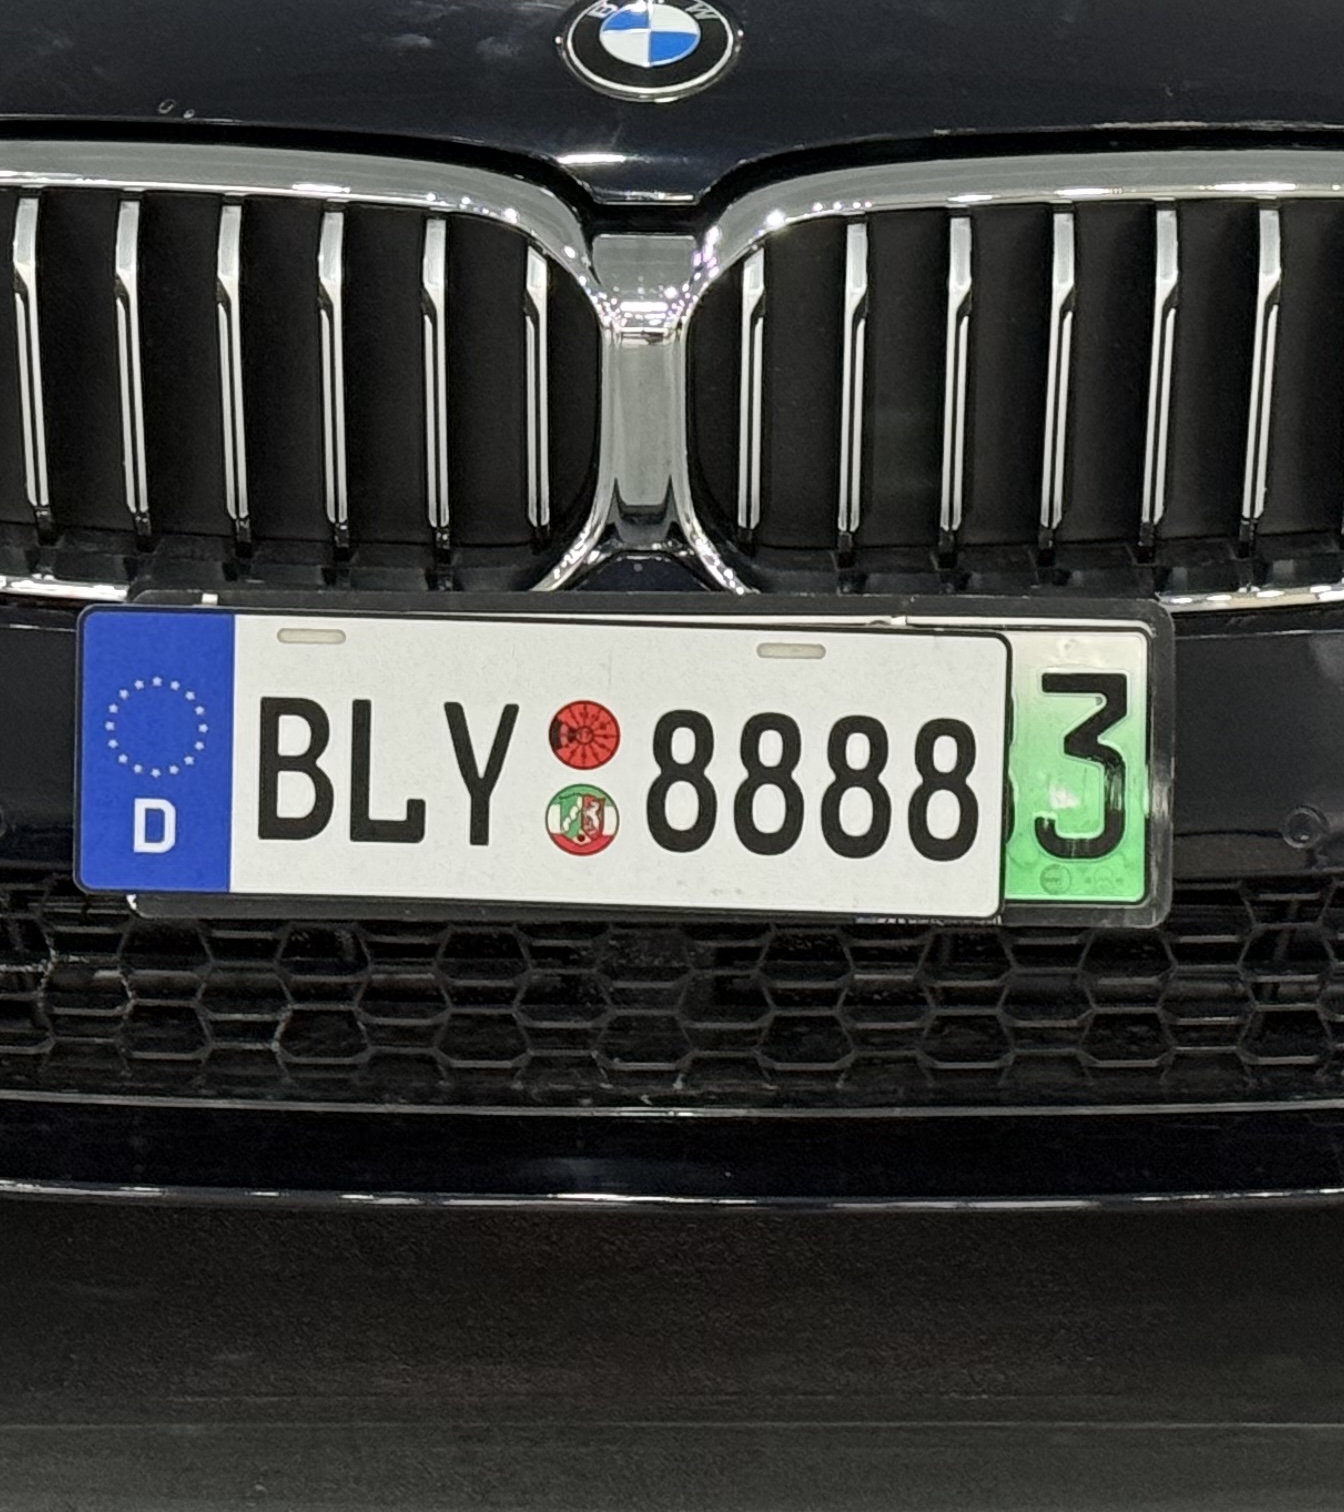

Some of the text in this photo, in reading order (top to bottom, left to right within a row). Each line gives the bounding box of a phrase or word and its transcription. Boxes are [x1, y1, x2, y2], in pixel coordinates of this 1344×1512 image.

[134, 798, 176, 853] D
[257, 696, 979, 862] BLY 8888
[1034, 672, 1128, 860] 3
